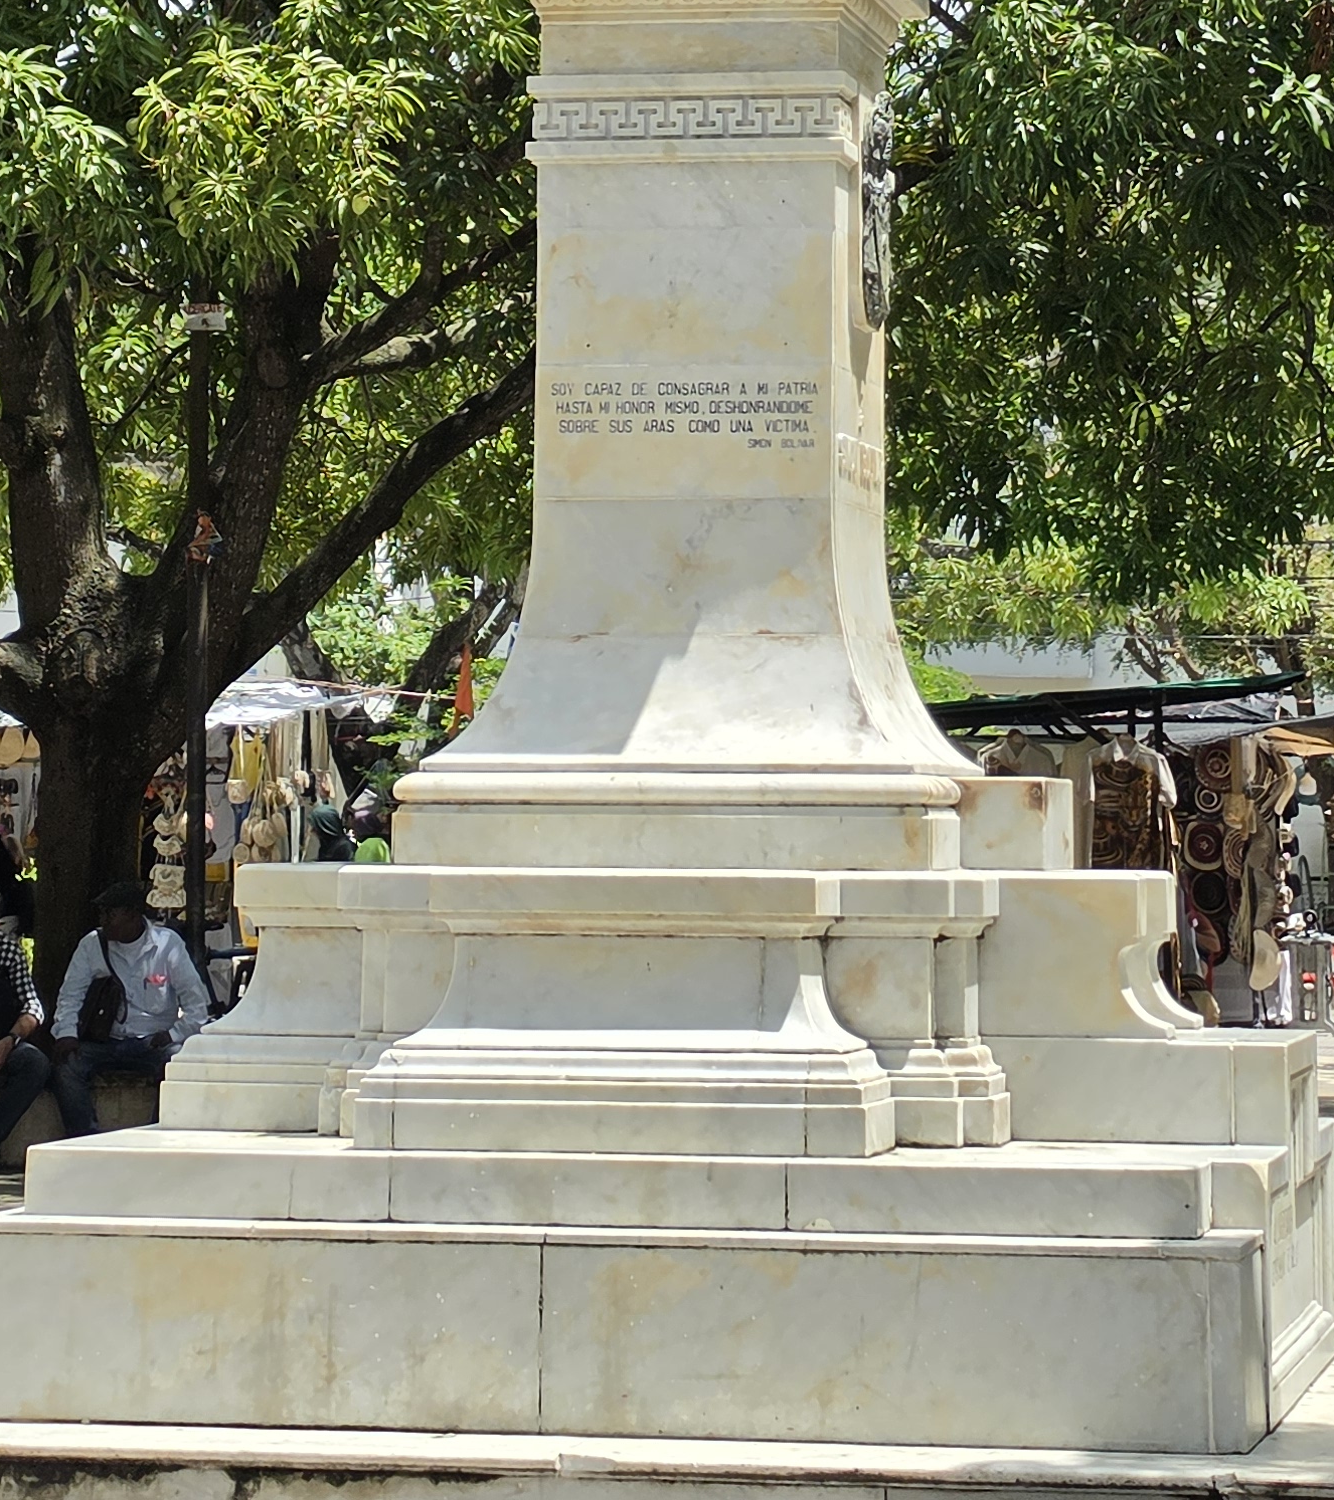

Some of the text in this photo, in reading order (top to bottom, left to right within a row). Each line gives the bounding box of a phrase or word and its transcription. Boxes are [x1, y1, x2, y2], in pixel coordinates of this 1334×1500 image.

[551, 382, 819, 396] SOY CAPAZ DE CONSAGRAR A MI PATRIA
[555, 401, 593, 415] HASTA
[599, 401, 610, 415] MI
[615, 401, 655, 415] HONOR
[709, 400, 814, 414] DESHONRANDOME
[558, 419, 600, 434] SOBRE
[608, 419, 633, 434] SUS
[643, 419, 675, 433] ARAS
[688, 419, 720, 434] COMO
[729, 419, 754, 433] UNA
[747, 438, 772, 449] SIMON
